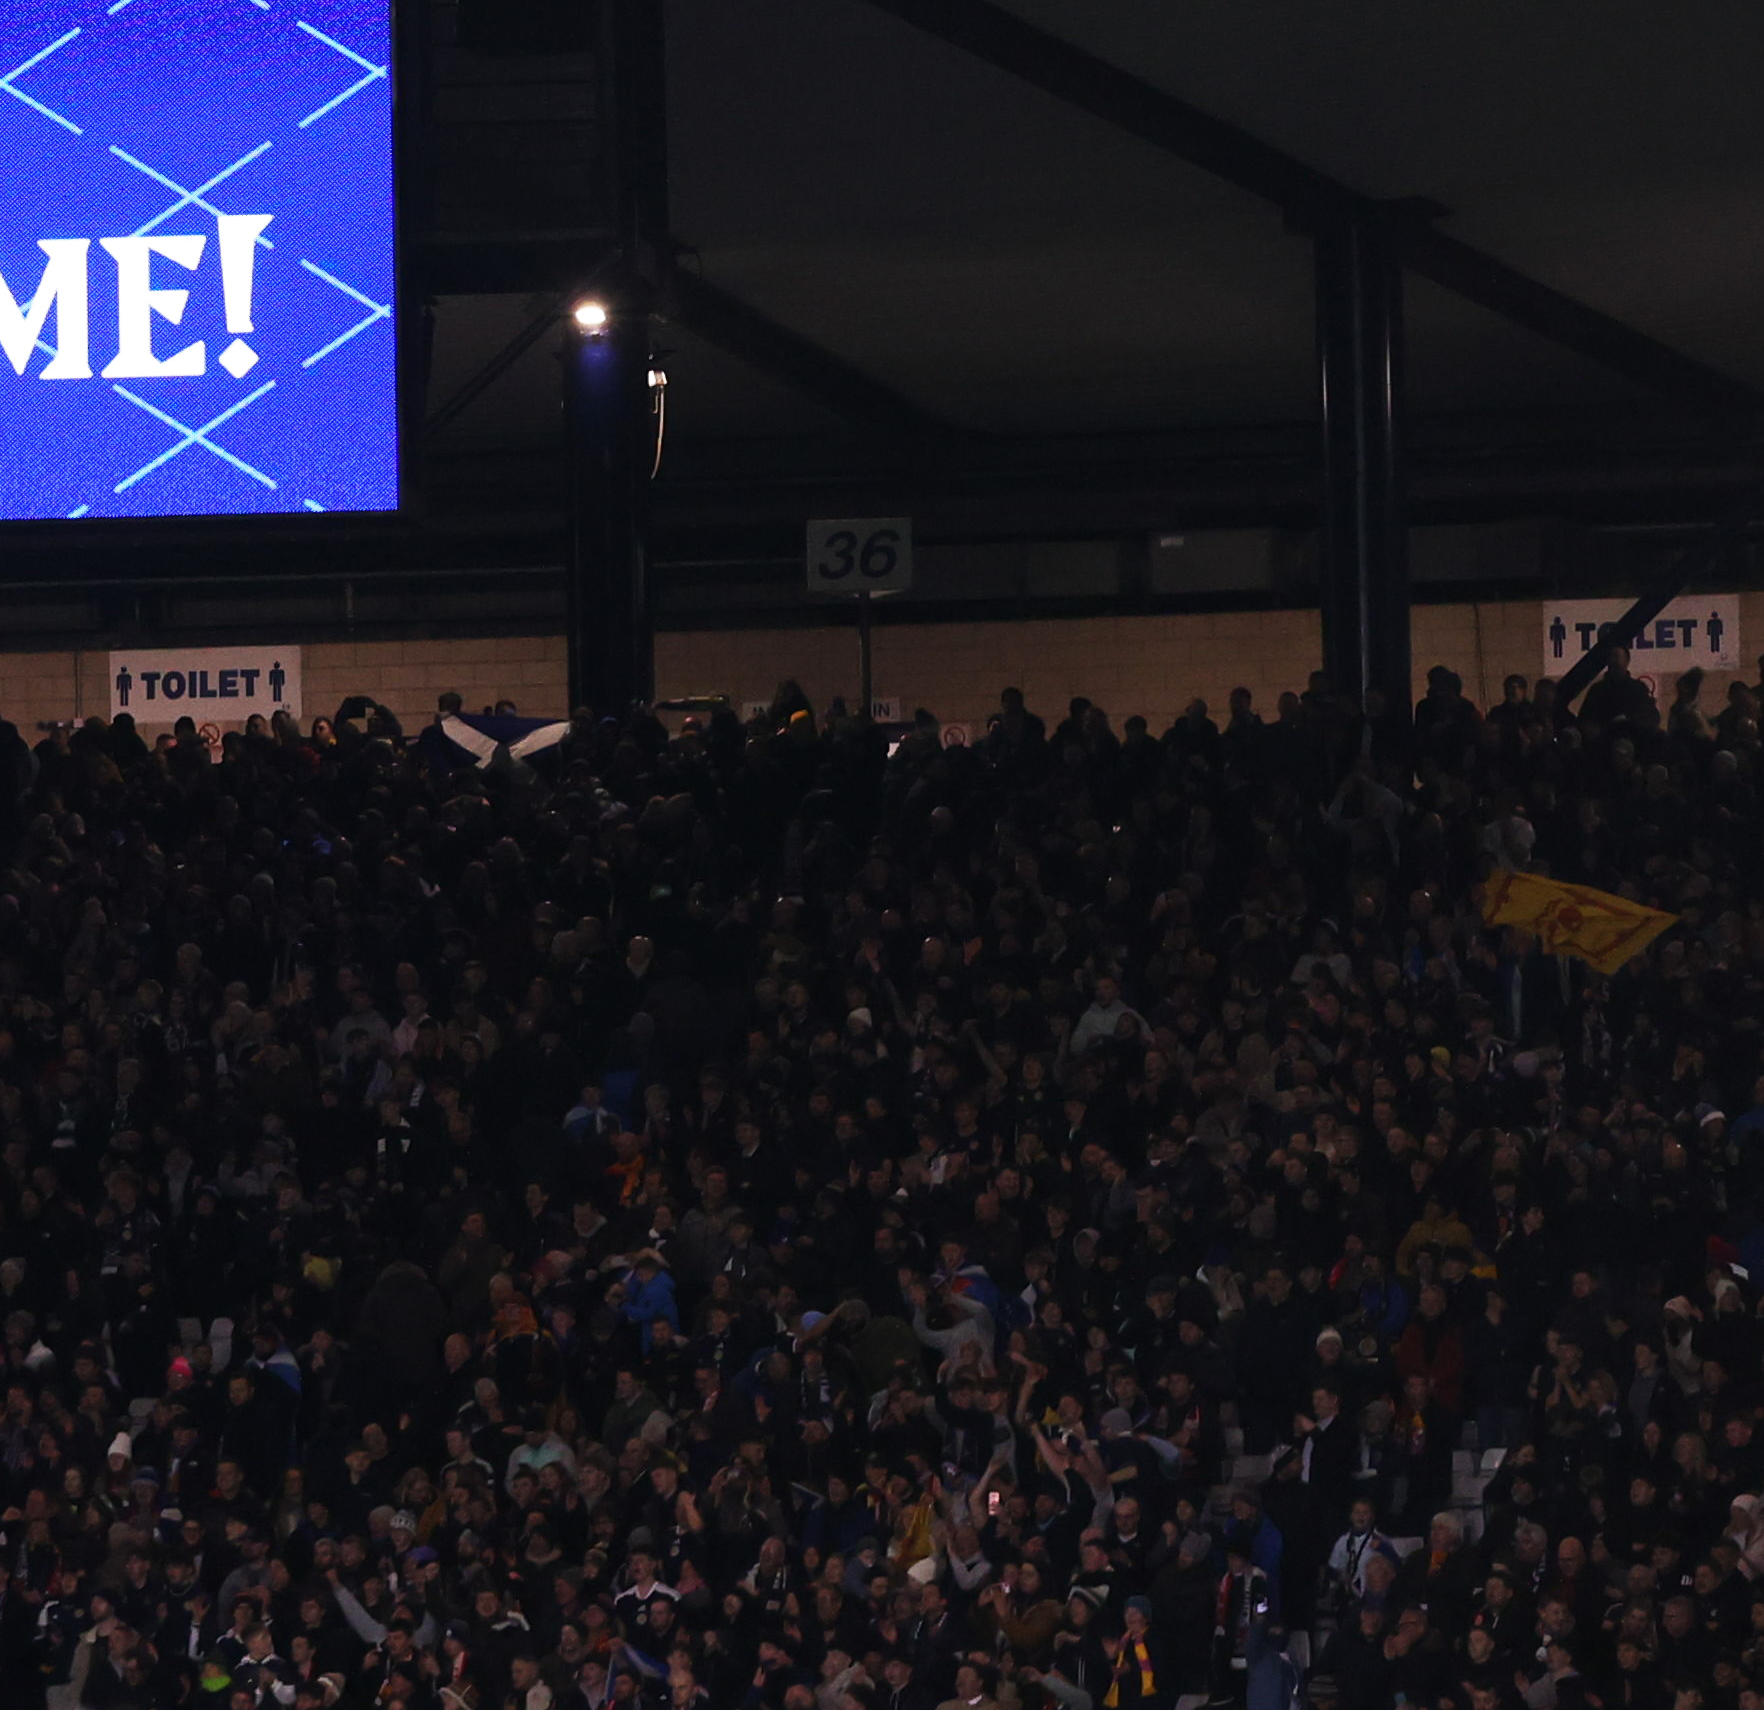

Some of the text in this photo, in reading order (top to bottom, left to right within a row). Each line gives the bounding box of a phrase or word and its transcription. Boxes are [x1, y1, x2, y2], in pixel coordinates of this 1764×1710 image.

[819, 528, 900, 580] 36
[1575, 619, 1698, 651] TLET
[141, 668, 260, 700] TOILET
[873, 703, 890, 717] IN
